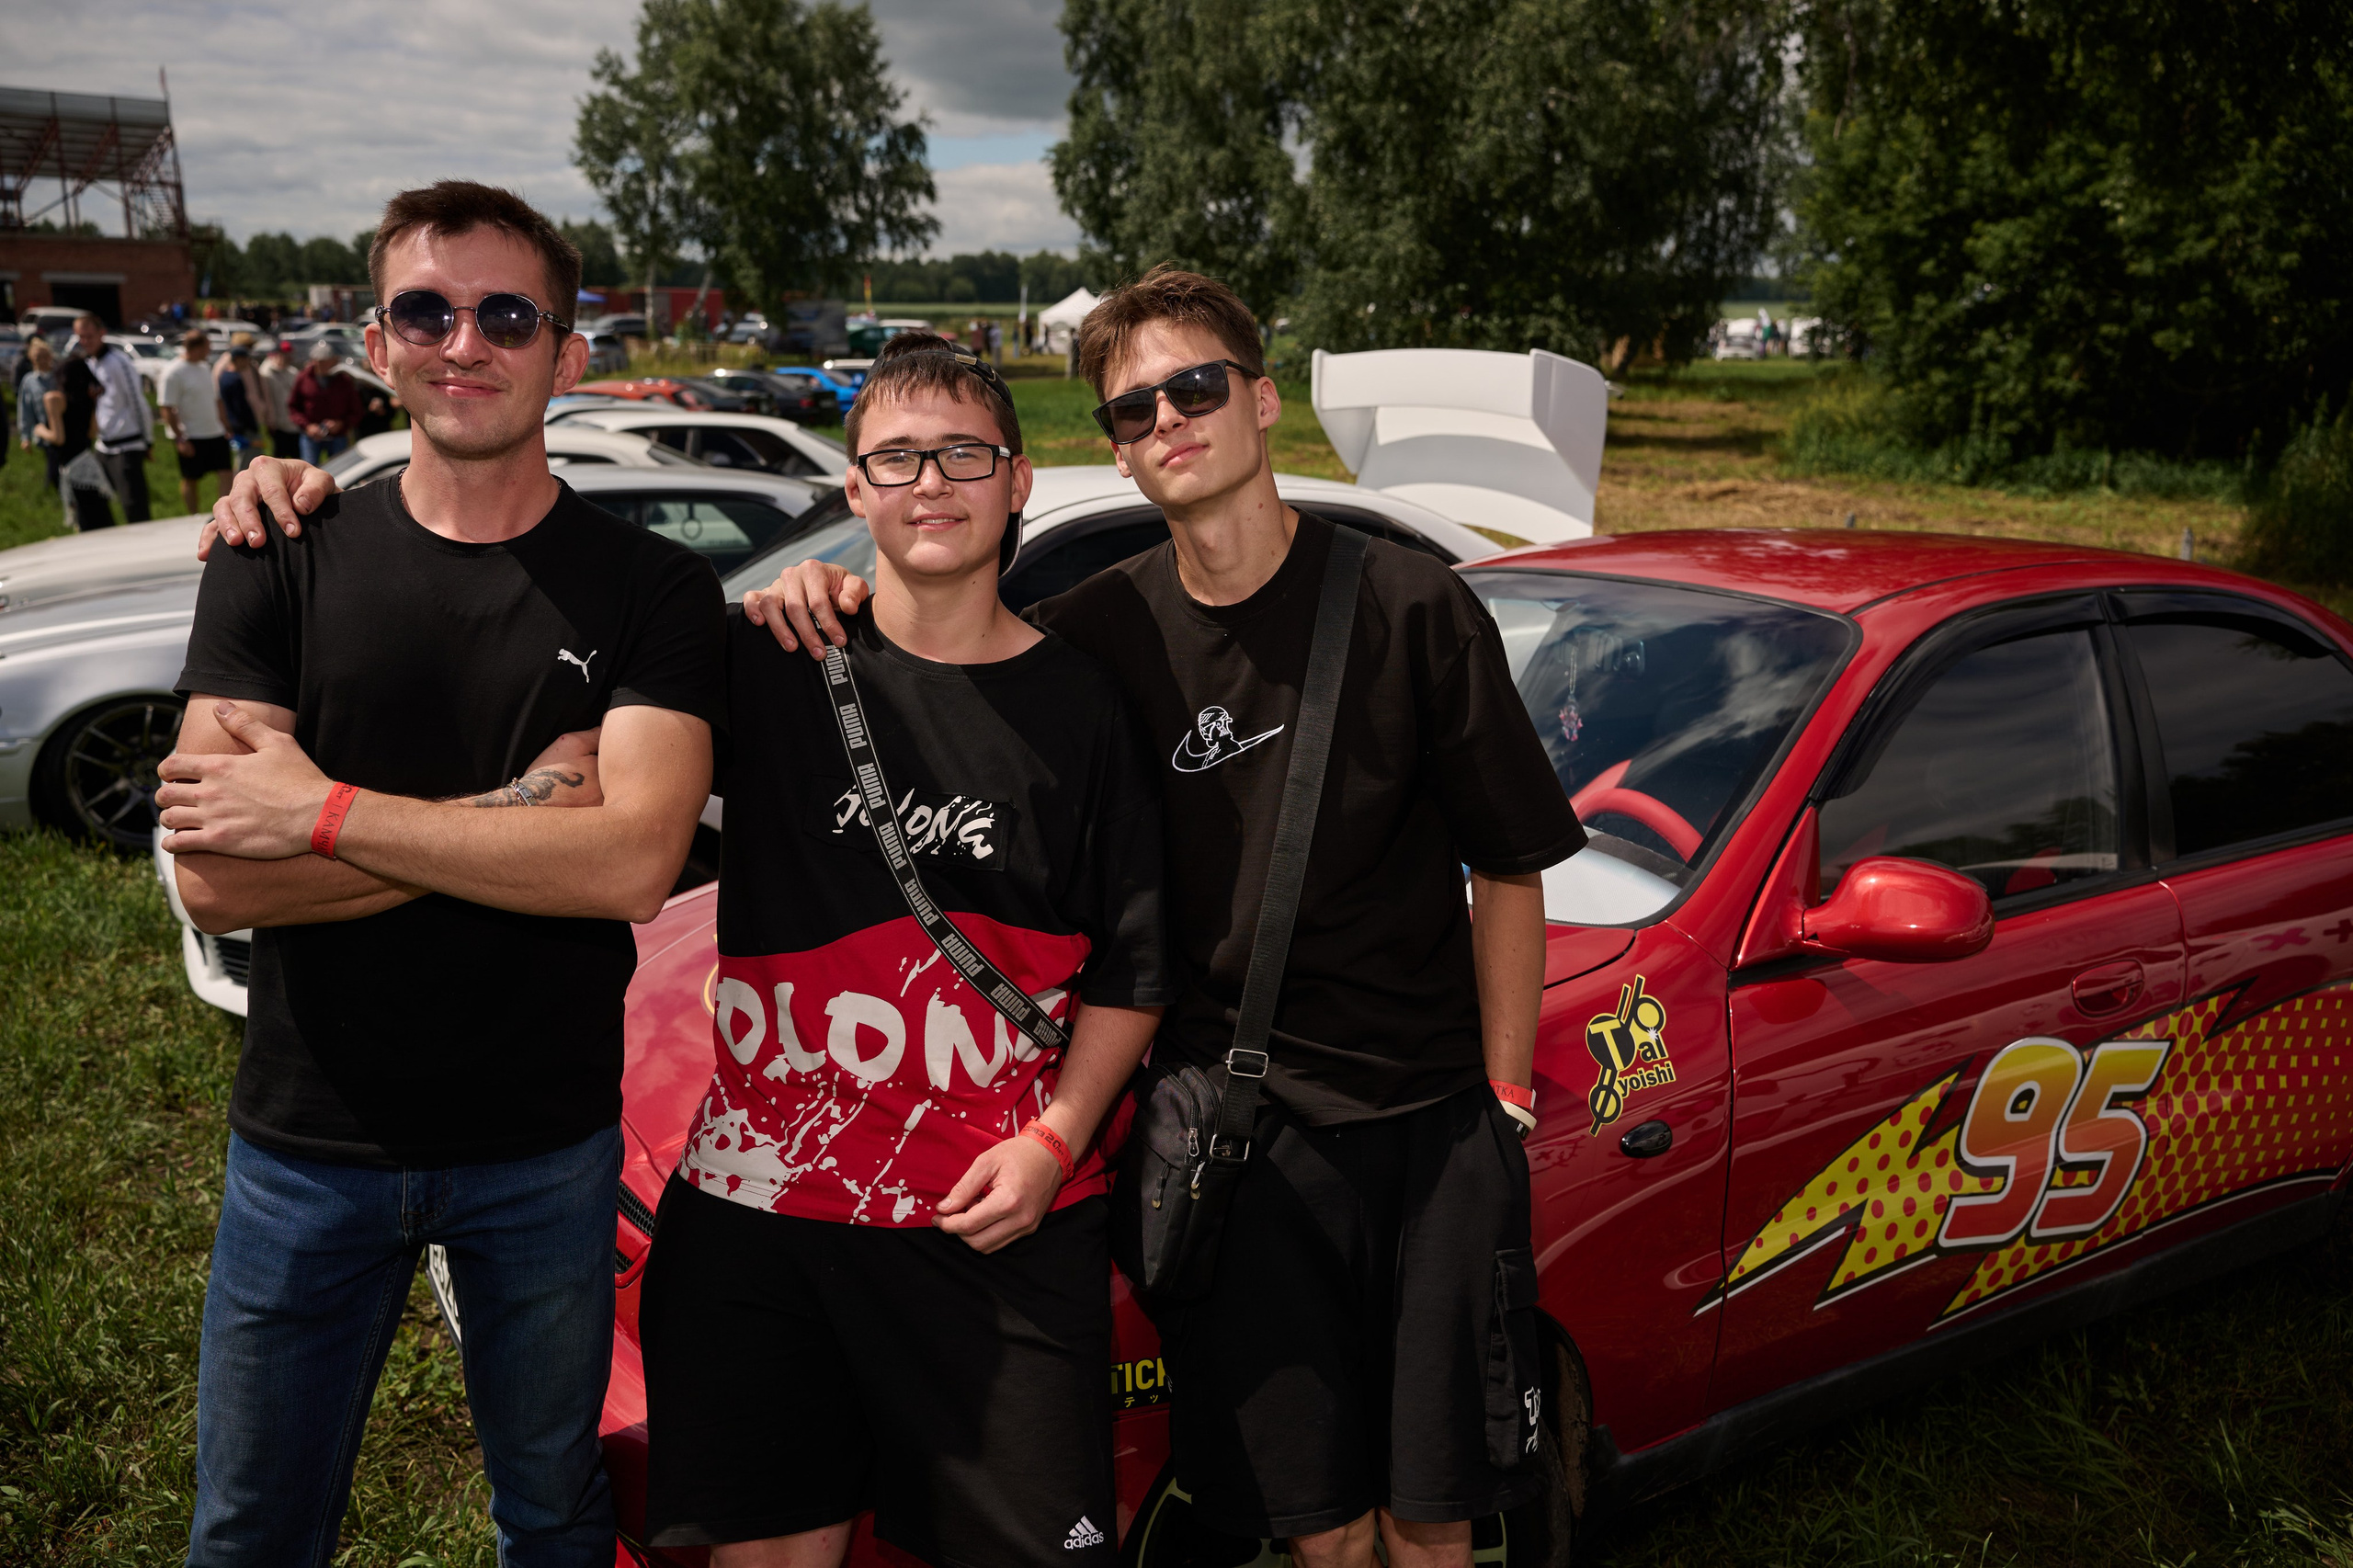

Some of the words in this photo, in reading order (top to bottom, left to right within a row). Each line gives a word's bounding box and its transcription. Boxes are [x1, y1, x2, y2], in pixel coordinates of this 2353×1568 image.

[838, 702, 868, 750] PUMA
[857, 762, 887, 810] PUMA
[878, 821, 908, 870] PUMA
[904, 878, 940, 926] PUMA
[940, 932, 985, 978] PUMA
[990, 982, 1031, 1022] PUMA
[1938, 1036, 2171, 1248] 95
[1063, 1531, 1105, 1551] adidas
